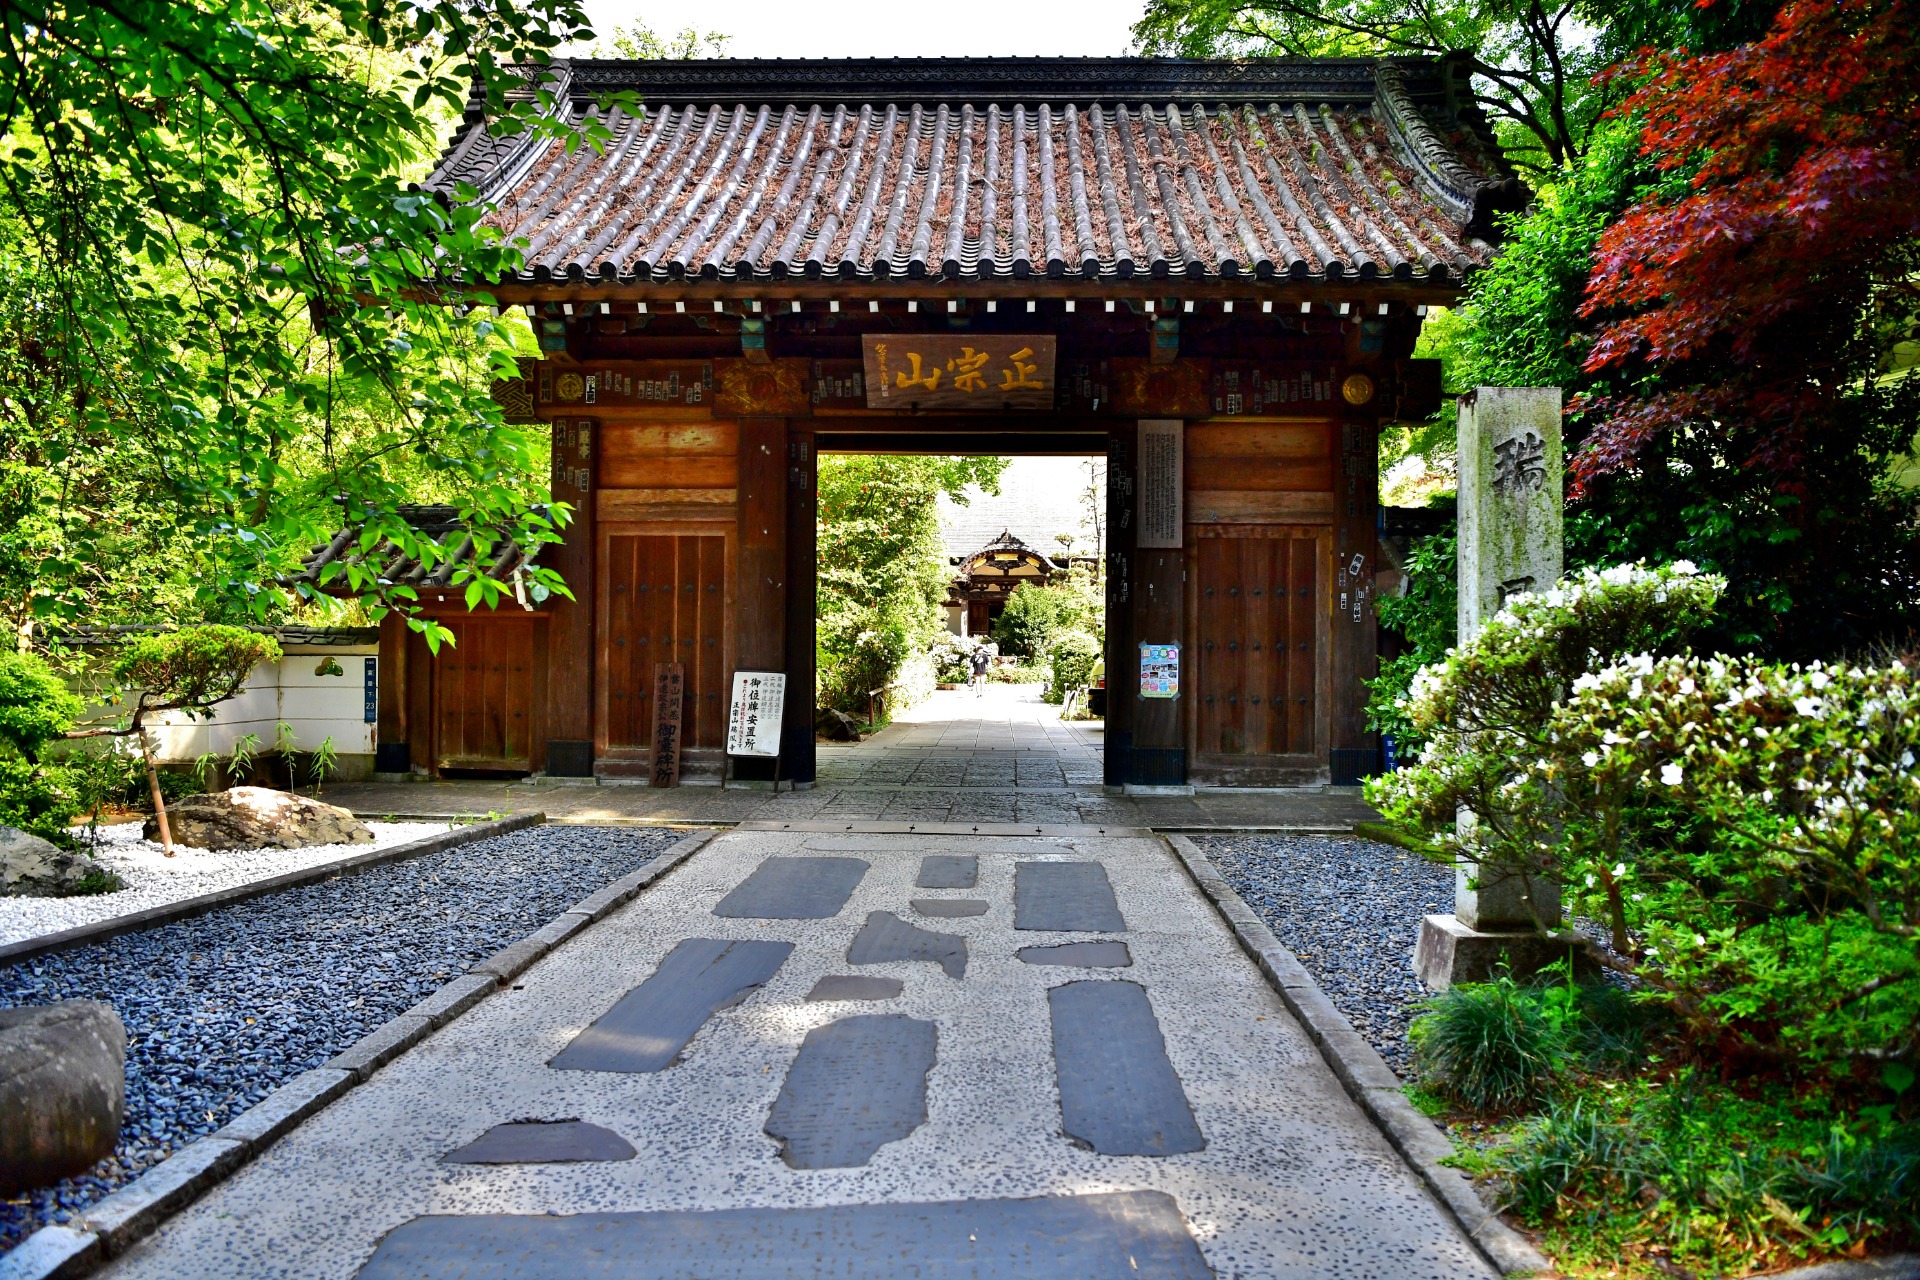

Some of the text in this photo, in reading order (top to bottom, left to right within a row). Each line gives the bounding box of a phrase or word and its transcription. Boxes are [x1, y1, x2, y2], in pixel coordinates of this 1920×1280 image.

[896, 347, 1045, 393] 正宗山
[744, 678, 761, 750] 御位牌安置所
